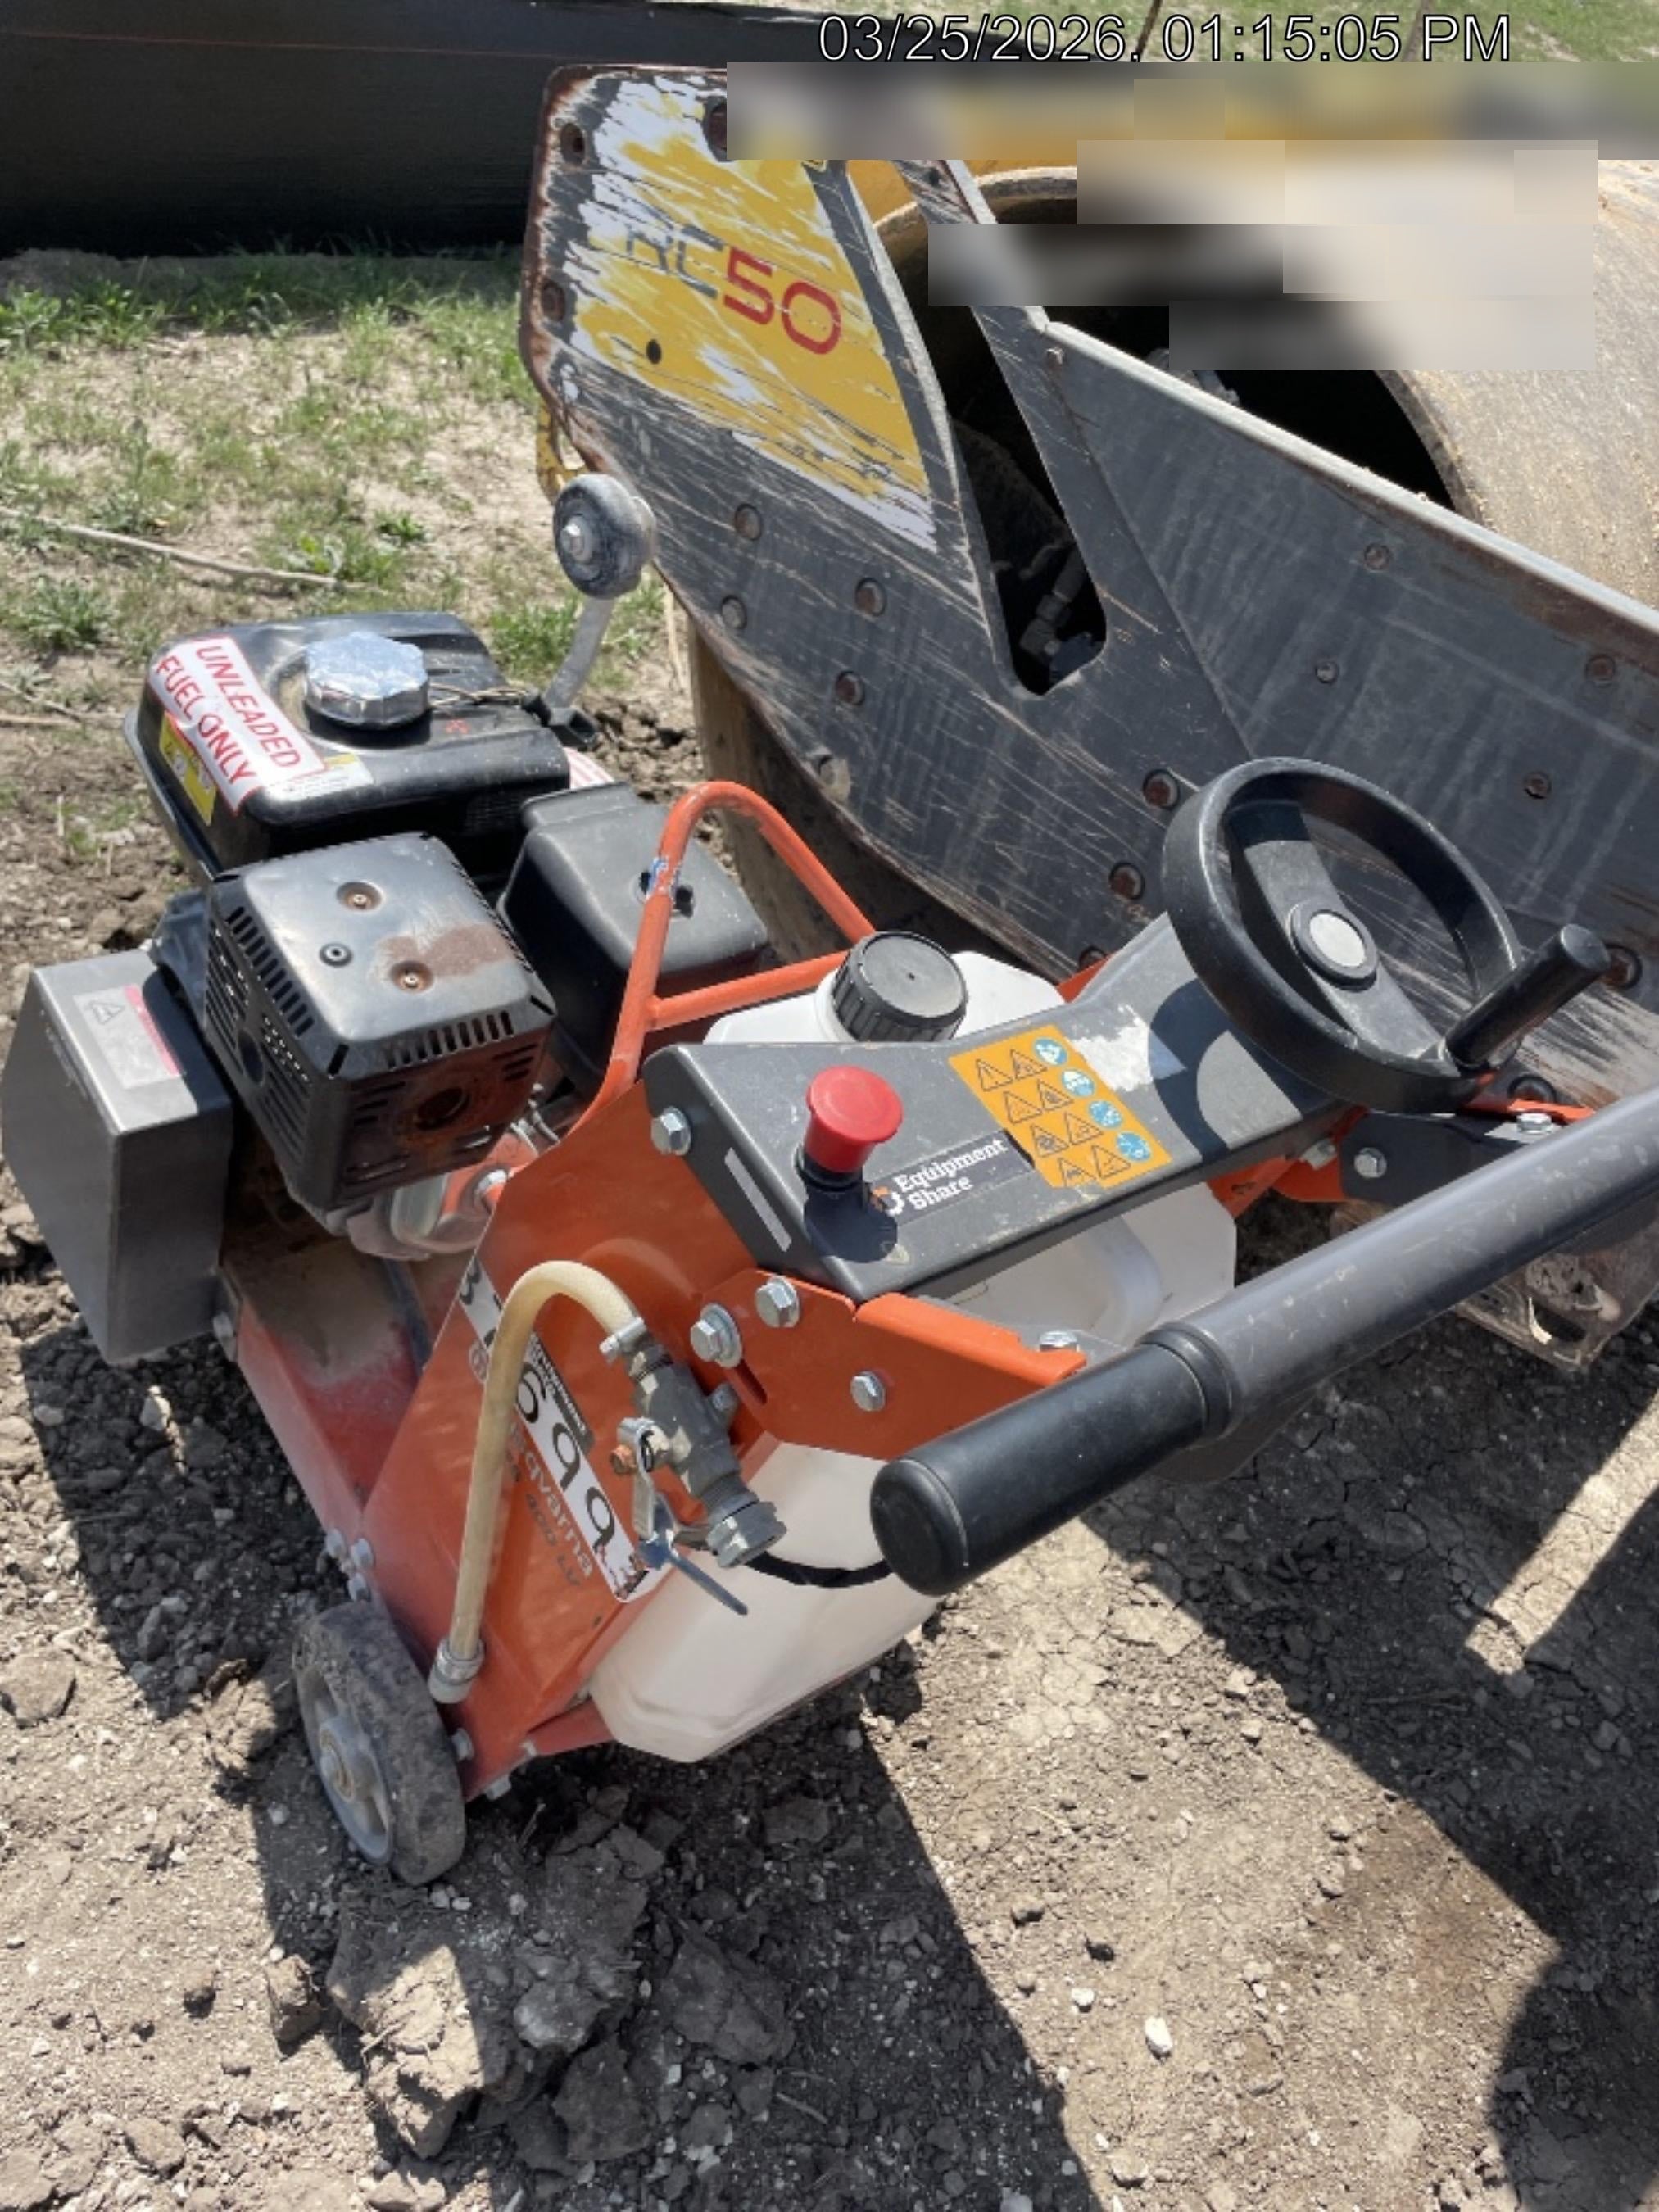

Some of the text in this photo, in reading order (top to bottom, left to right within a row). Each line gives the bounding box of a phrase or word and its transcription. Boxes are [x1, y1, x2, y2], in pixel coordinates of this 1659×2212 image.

[156, 655, 256, 785] FUEL ONLY
[196, 646, 300, 768] UNLEADED
[892, 1138, 1009, 1193] Equipment
[908, 1176, 974, 1210] Share
